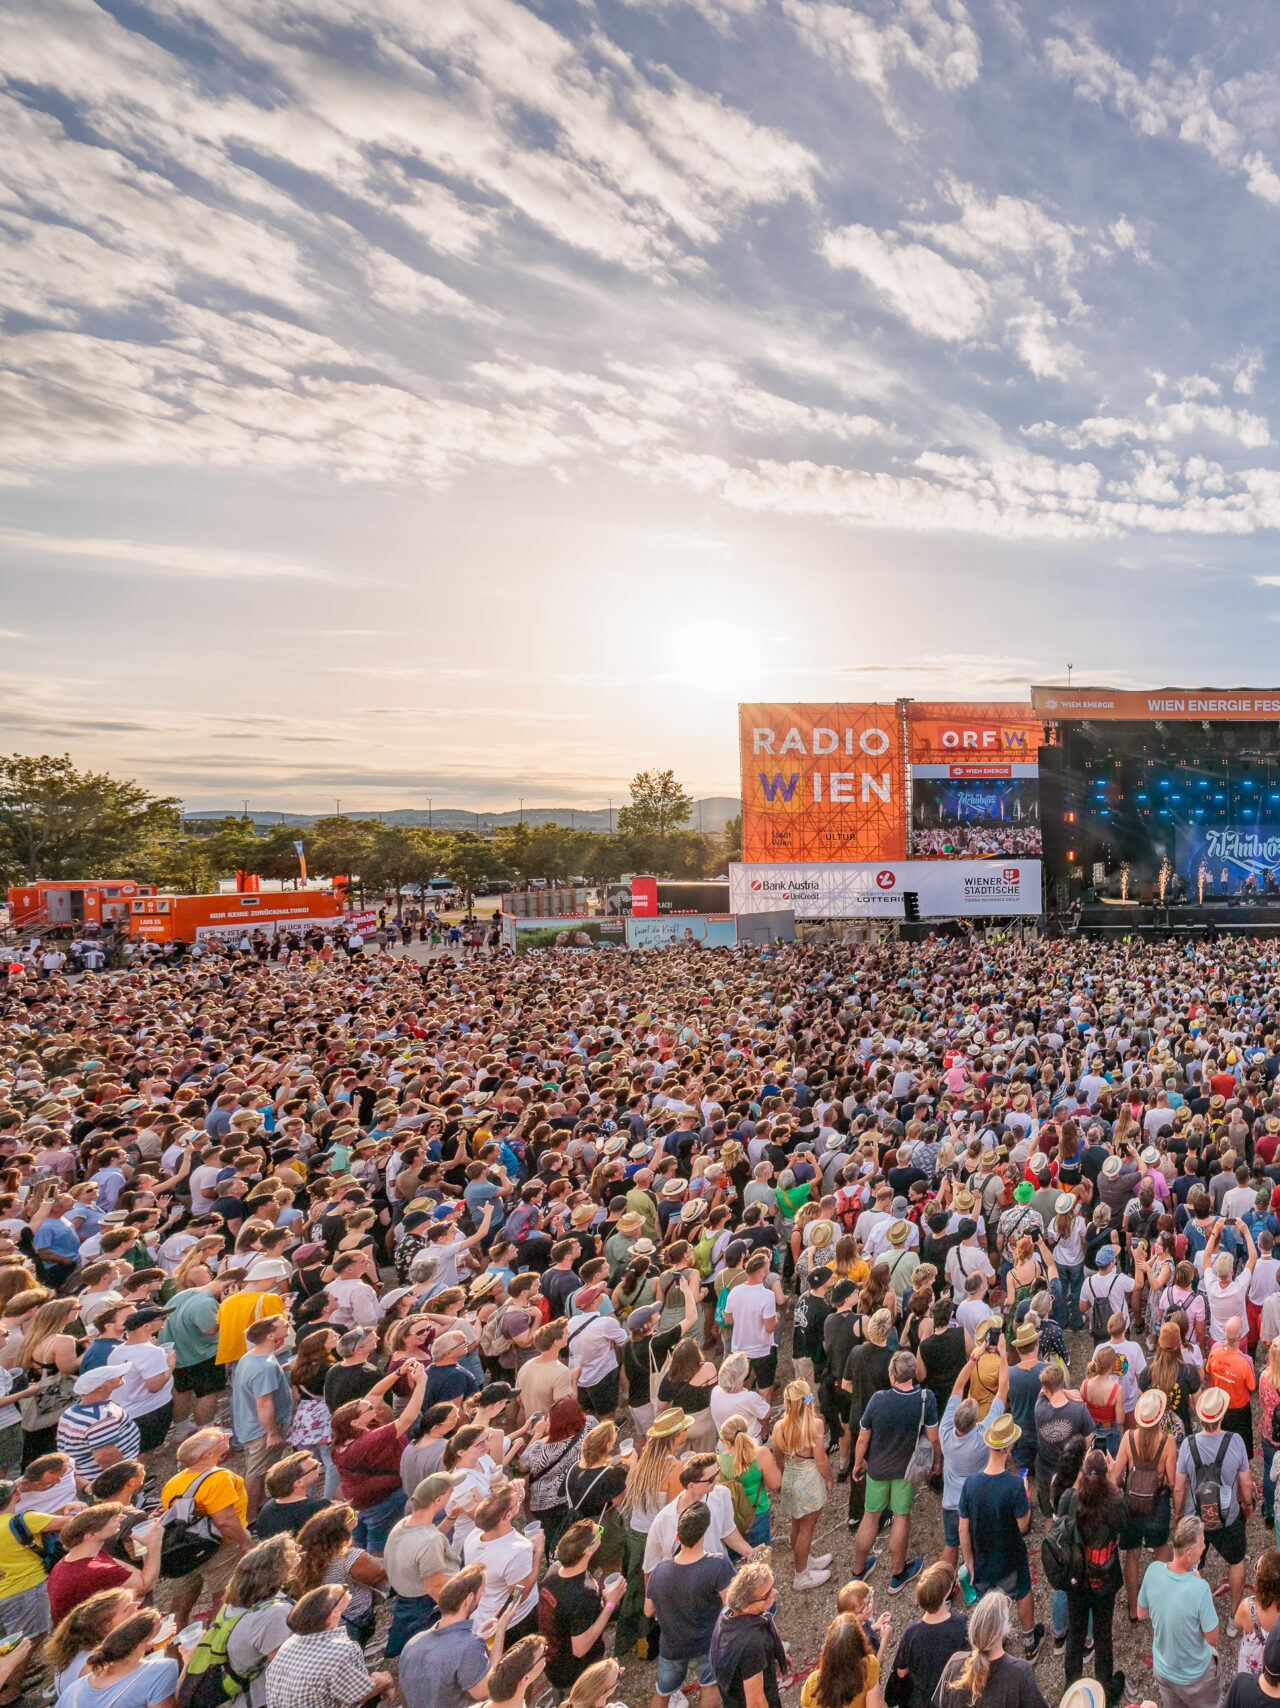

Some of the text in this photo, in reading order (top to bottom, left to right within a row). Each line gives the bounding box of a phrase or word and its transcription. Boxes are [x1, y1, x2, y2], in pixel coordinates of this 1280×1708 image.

[1147, 699, 1185, 712] WIEN
[1188, 699, 1250, 712] ENERGIE
[753, 727, 890, 756] RADIO
[942, 731, 997, 748] ORF
[762, 881, 819, 891] Bank Austria
[964, 877, 1002, 885] WIENER
